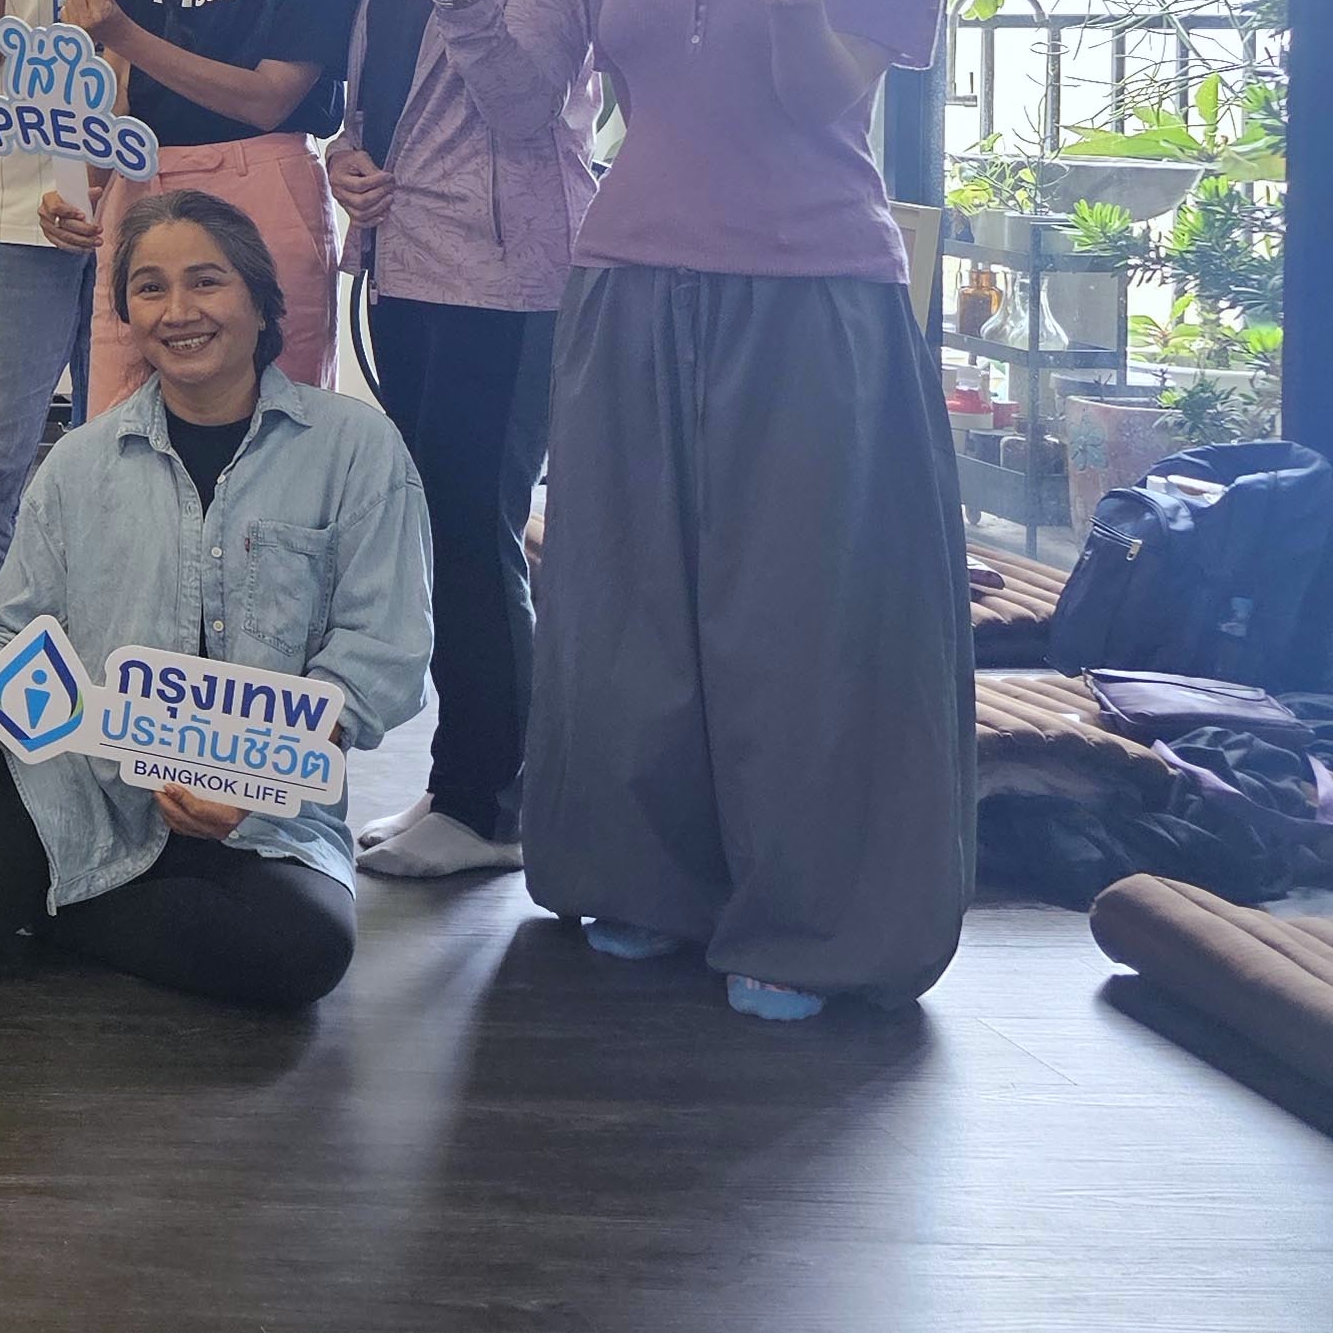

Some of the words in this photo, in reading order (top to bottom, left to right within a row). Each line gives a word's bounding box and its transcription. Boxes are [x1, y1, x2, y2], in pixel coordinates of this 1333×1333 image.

[3, 27, 105, 109] ใส่ใจ
[118, 659, 330, 732] กรุงเทพ
[101, 700, 331, 784] ประกันชีวิต
[134, 760, 239, 795] BANGKOK
[243, 782, 289, 805] LIFE
